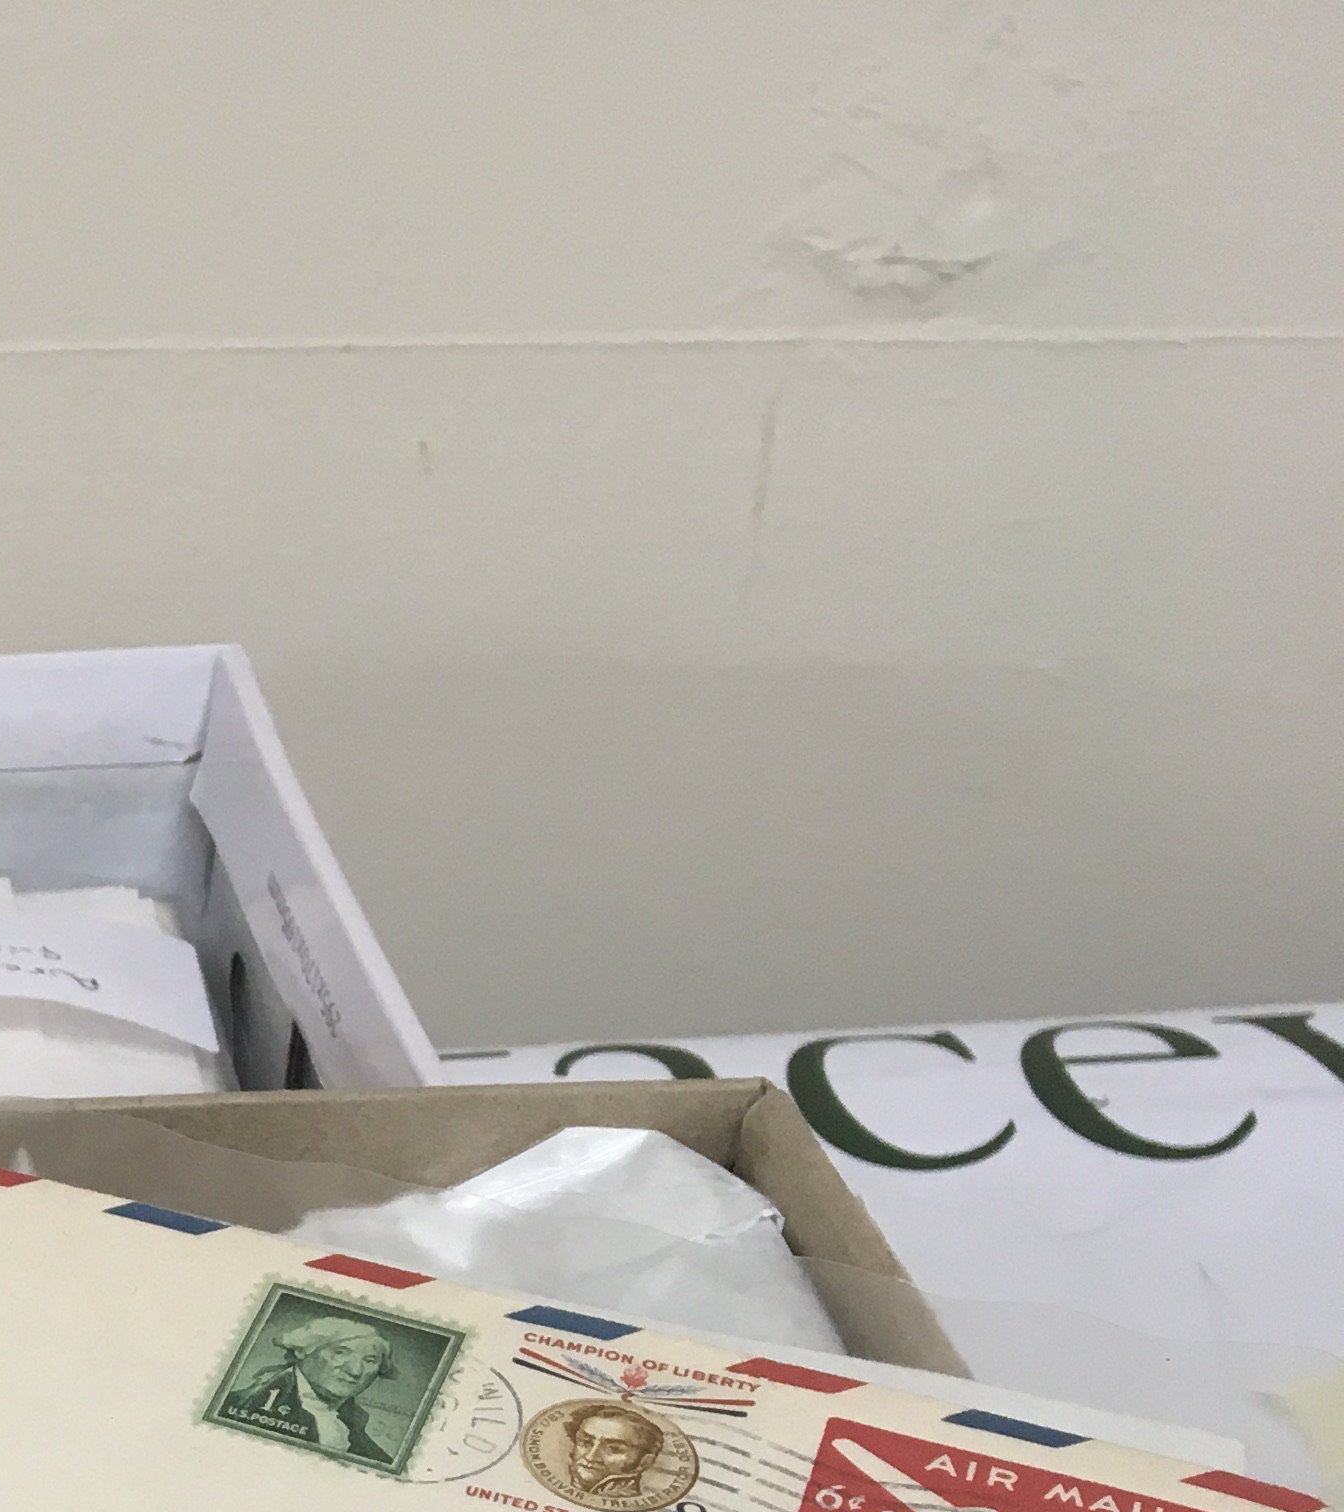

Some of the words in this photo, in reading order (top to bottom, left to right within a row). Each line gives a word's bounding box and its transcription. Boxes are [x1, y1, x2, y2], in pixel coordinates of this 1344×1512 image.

[524, 1332, 634, 1366] CHAMPION
[642, 1359, 669, 1375] OF
[672, 1366, 761, 1394] LIBERTY
[925, 1452, 1017, 1493] AIR
